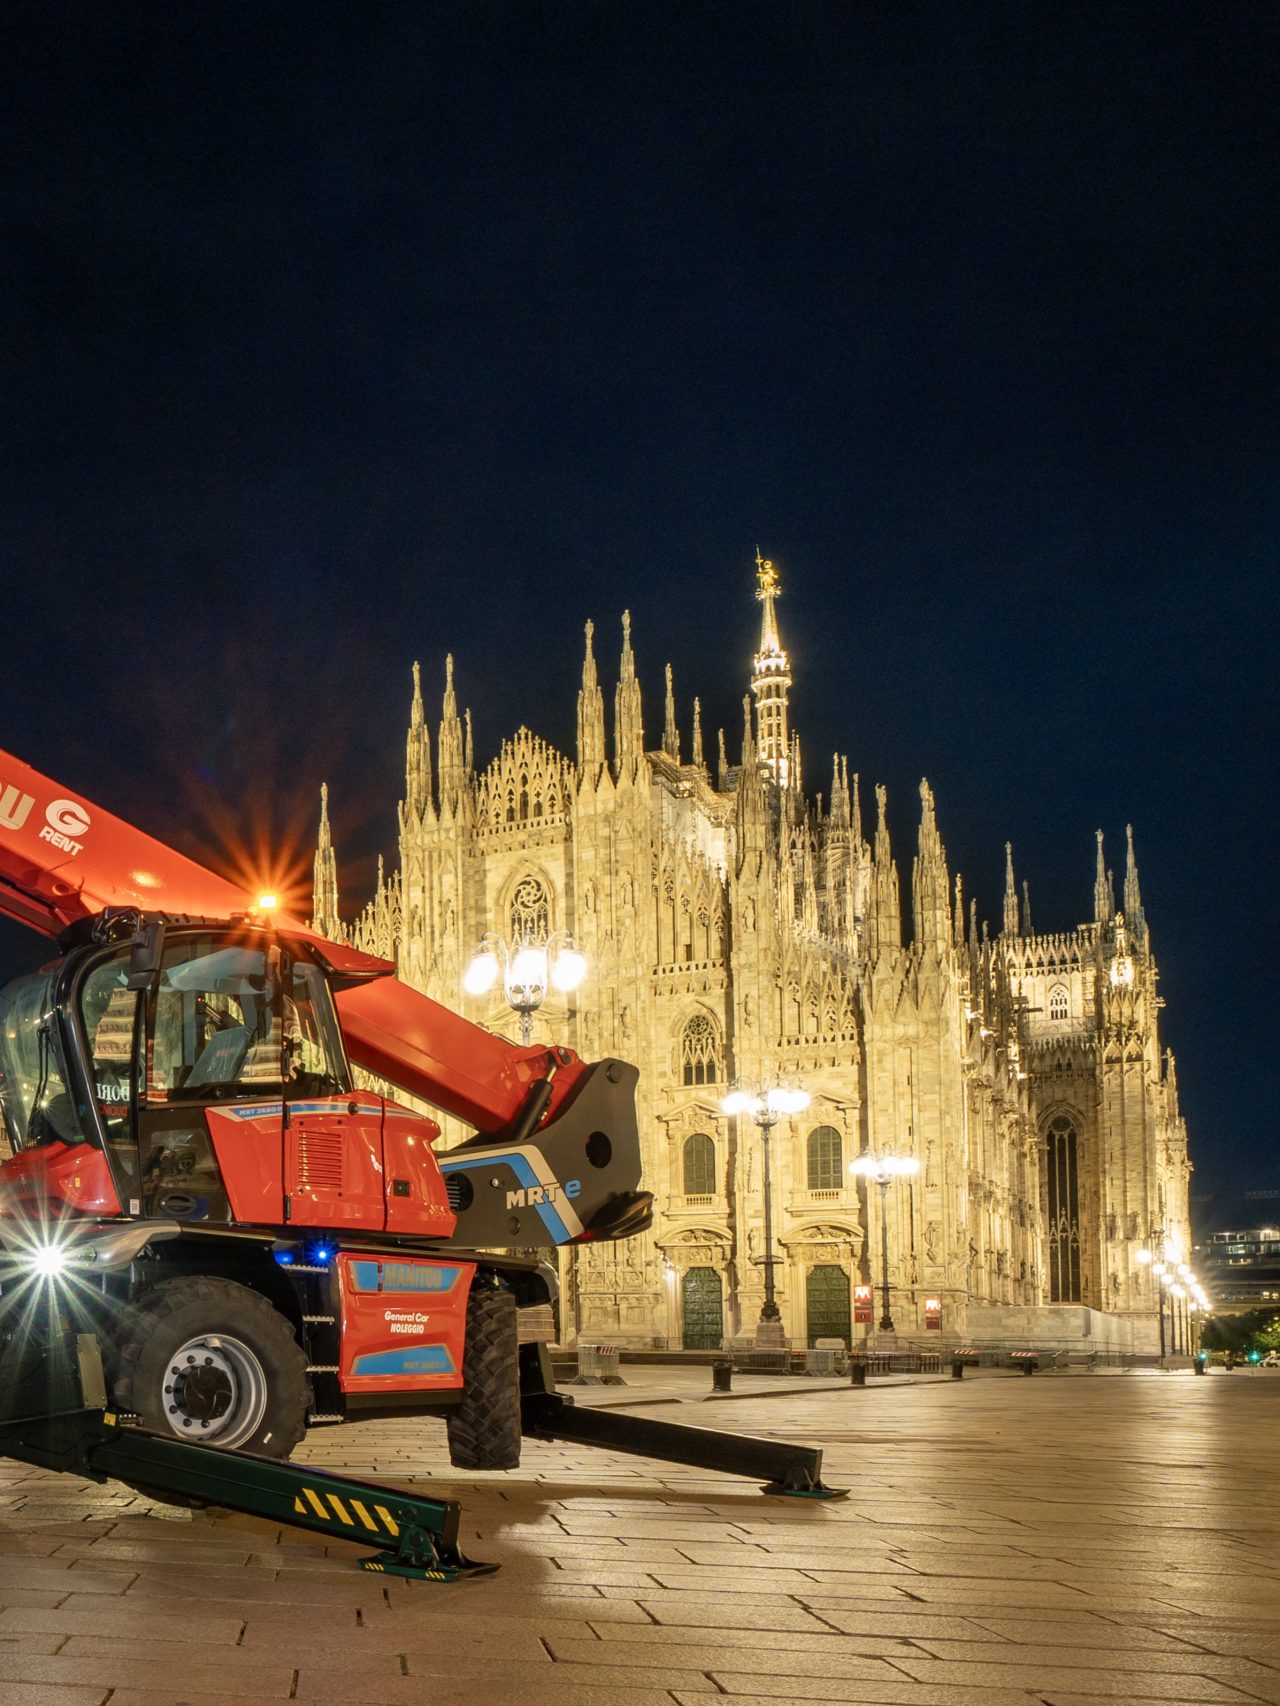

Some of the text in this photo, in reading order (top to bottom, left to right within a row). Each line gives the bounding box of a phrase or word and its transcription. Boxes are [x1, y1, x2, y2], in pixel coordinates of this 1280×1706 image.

[45, 799, 91, 836] G
[39, 825, 84, 856] RENT
[506, 1183, 560, 1210] MRT
[384, 1265, 442, 1289] MANITOU
[384, 1311, 430, 1323] General Car
[390, 1323, 425, 1334] NOLEGGIO
